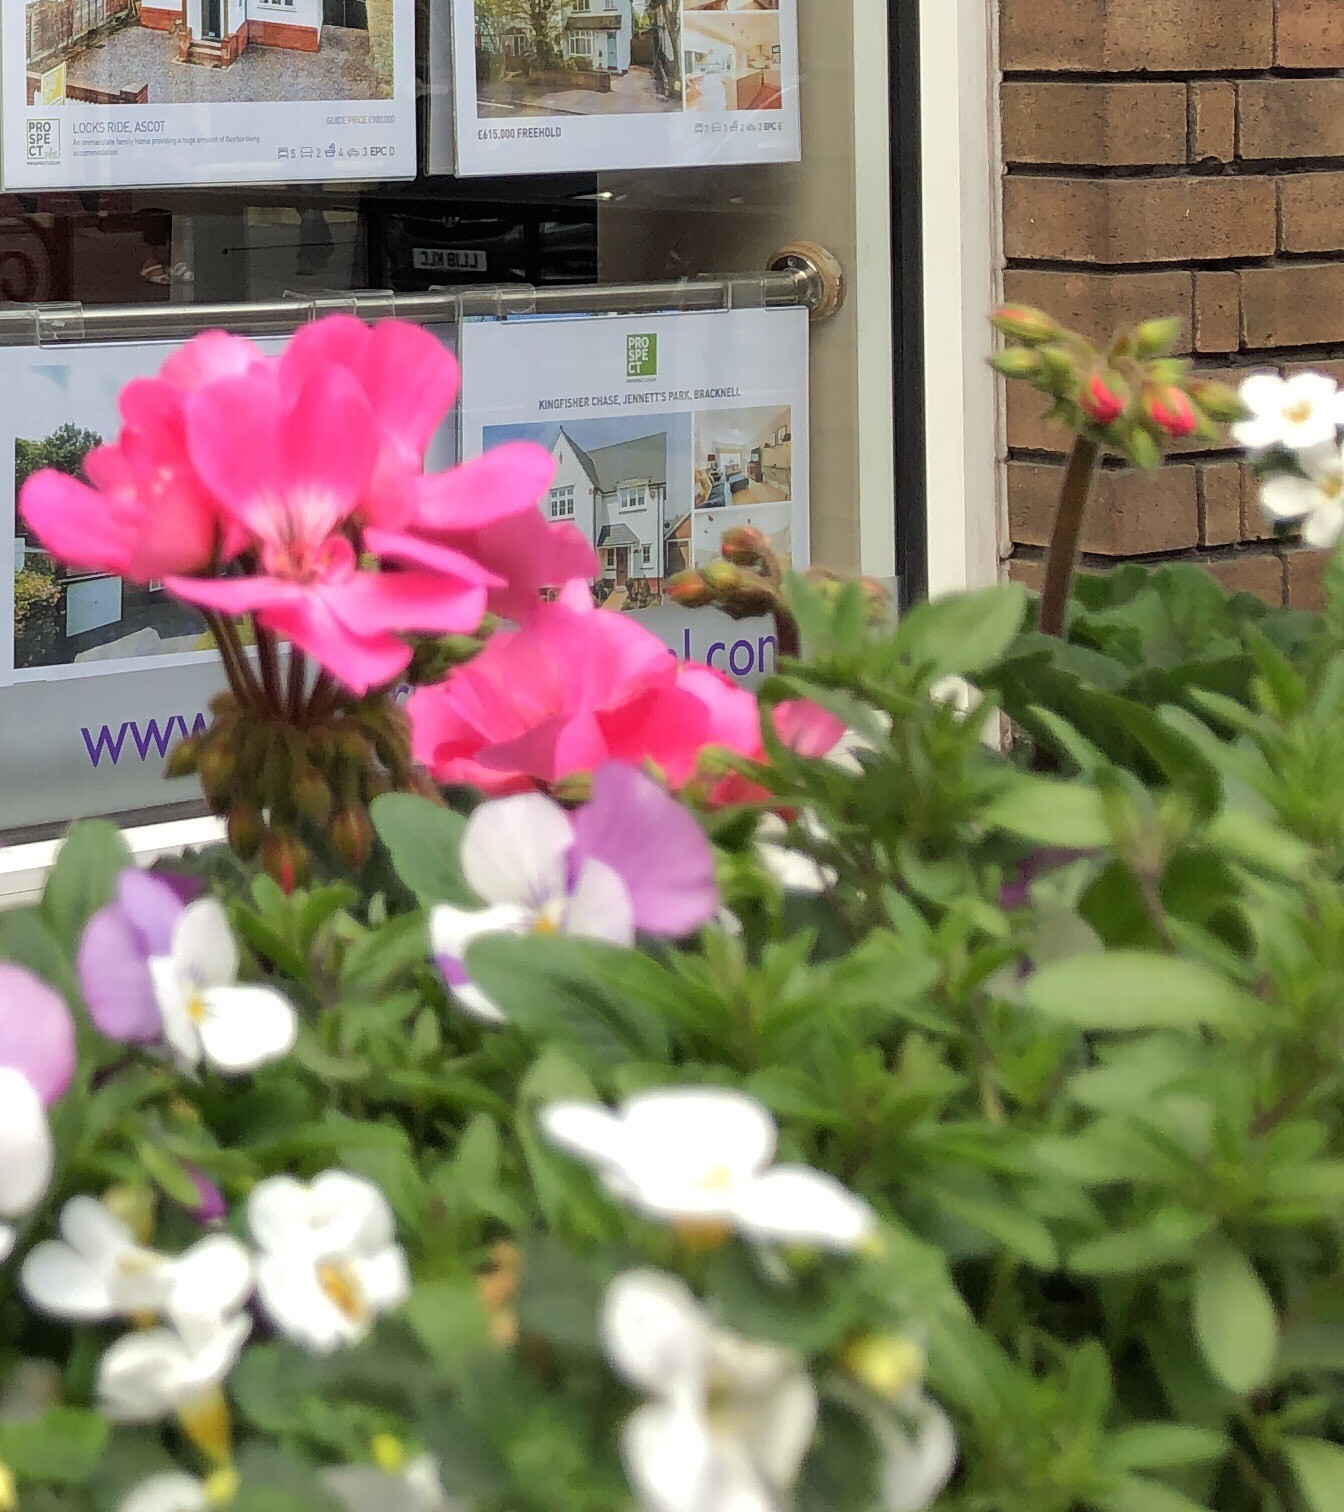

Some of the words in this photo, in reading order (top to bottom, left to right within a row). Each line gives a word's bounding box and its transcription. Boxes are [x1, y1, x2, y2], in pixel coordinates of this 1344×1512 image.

[29, 122, 51, 133] PRO
[73, 122, 104, 134] LOCKS
[107, 121, 132, 134] RIDE,
[134, 120, 166, 132] ASCOT
[29, 133, 50, 144] SPE
[478, 128, 515, 141] £615,000
[517, 127, 562, 139] FREEHOLD
[29, 145, 43, 156] CT
[371, 147, 387, 156] EPC
[629, 336, 649, 349] PRO
[628, 349, 648, 361] SPE
[628, 361, 642, 374] CT
[539, 396, 590, 410] KINGFISHER
[591, 394, 621, 407] CHASE,
[669, 390, 692, 402] PARK,
[694, 387, 741, 400] BRACKNELL
